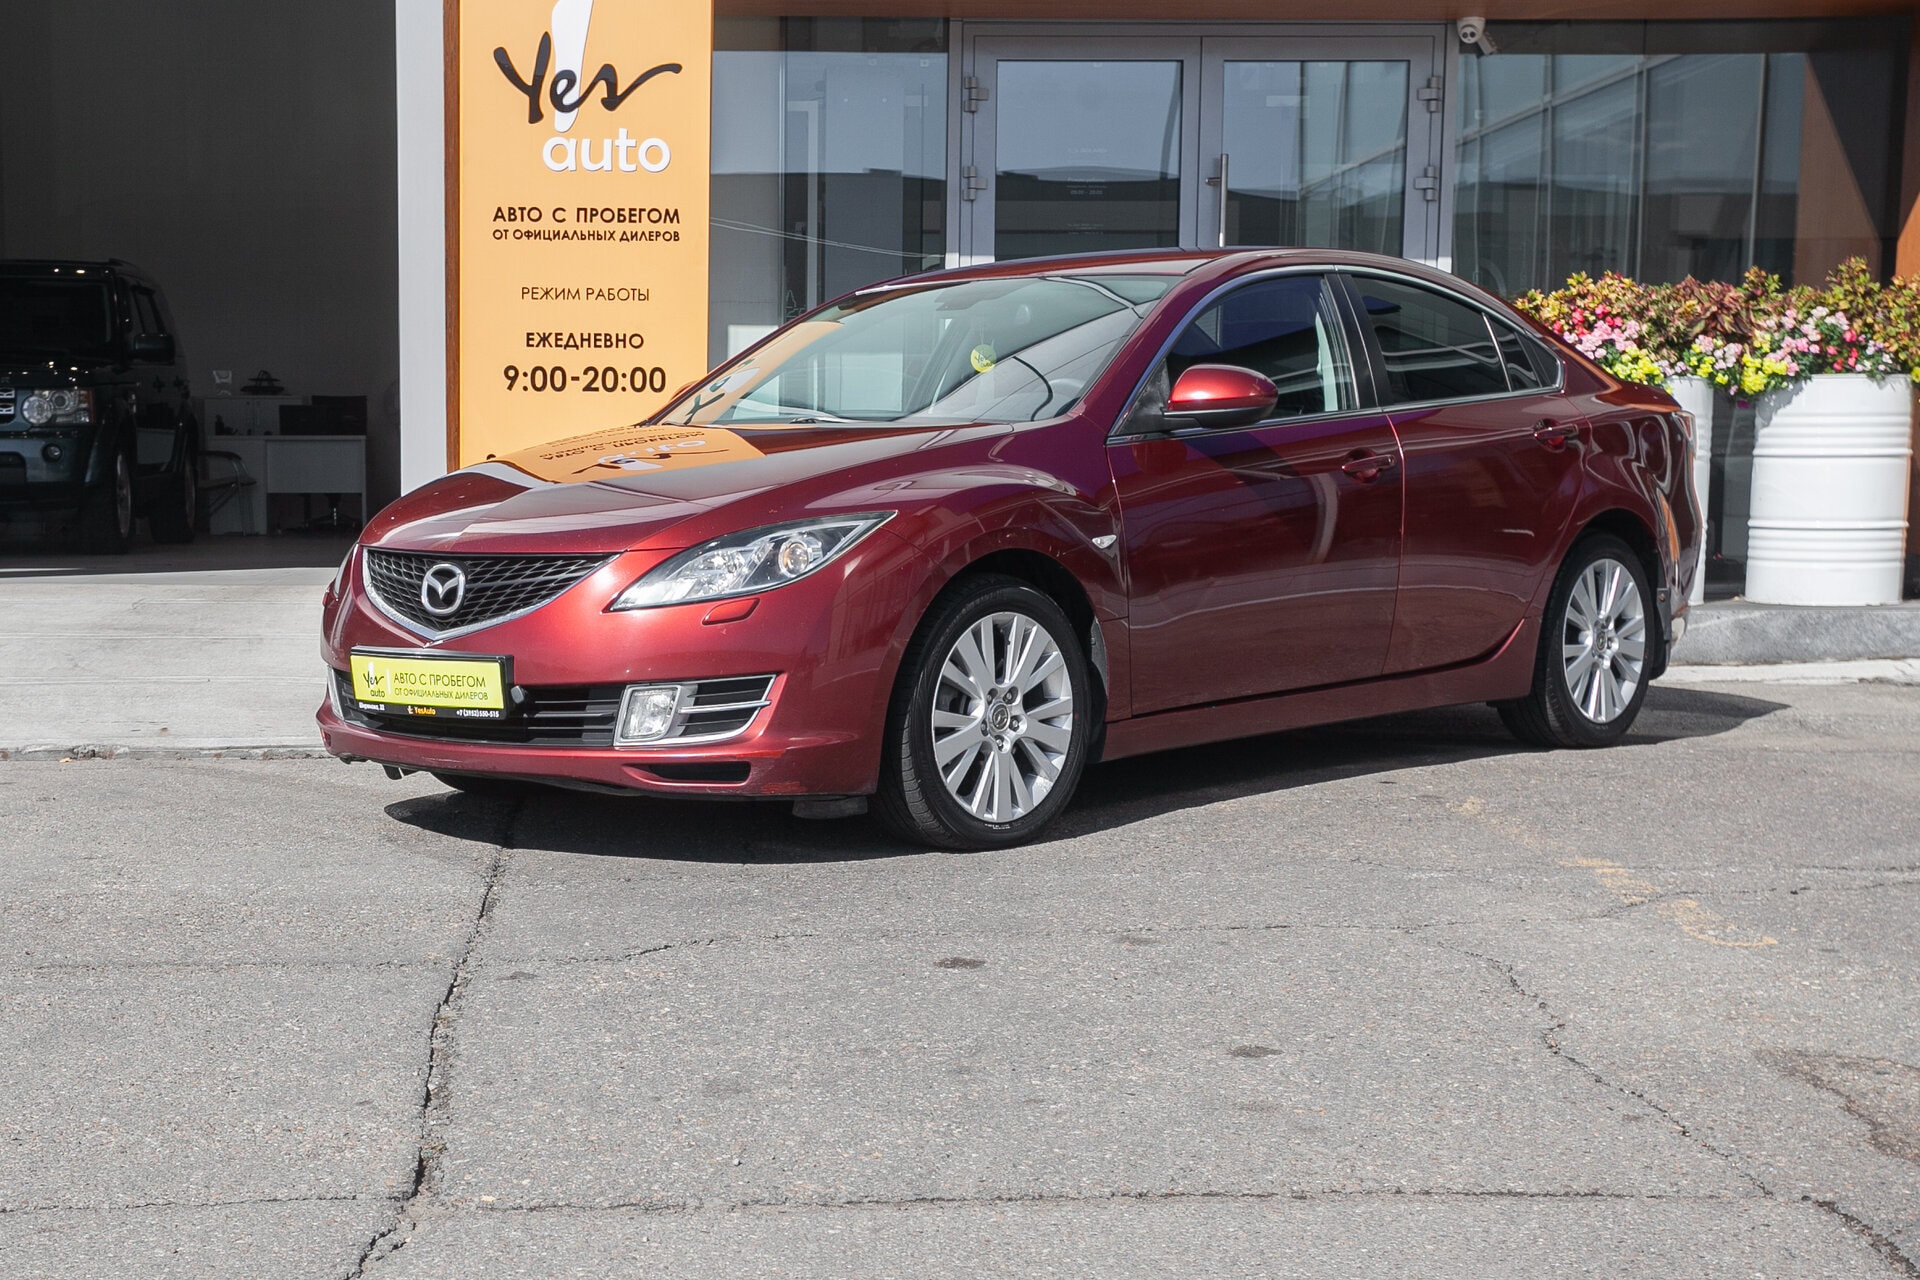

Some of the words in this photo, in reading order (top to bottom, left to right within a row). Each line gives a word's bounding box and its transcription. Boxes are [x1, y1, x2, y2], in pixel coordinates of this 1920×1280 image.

[493, 31, 683, 124] Yes
[542, 128, 672, 173] auto
[492, 206, 543, 223] АВТО
[552, 207, 567, 223] С
[576, 207, 680, 224] ПРОБЕГОМ
[492, 229, 509, 241] ОТ
[512, 229, 616, 242] ОФИЦИАЛЬНЫХ
[619, 230, 680, 242] ДИЛЕРОВ
[521, 286, 581, 301] РЕЖИМ
[586, 287, 650, 302] РАБОТЫ
[525, 332, 645, 350] ЕЖЕДНЕВНО
[503, 364, 667, 393] 9:00-20:00
[394, 672, 417, 685] АВТО
[419, 673, 427, 685] С
[429, 674, 486, 688] ПРОБЕГОМ
[370, 688, 386, 698] auto
[394, 688, 402, 696] ОТ
[403, 688, 453, 699] ОФИЦИАЛЬНЫХ
[455, 690, 488, 700] ДИЛЕРОВ
